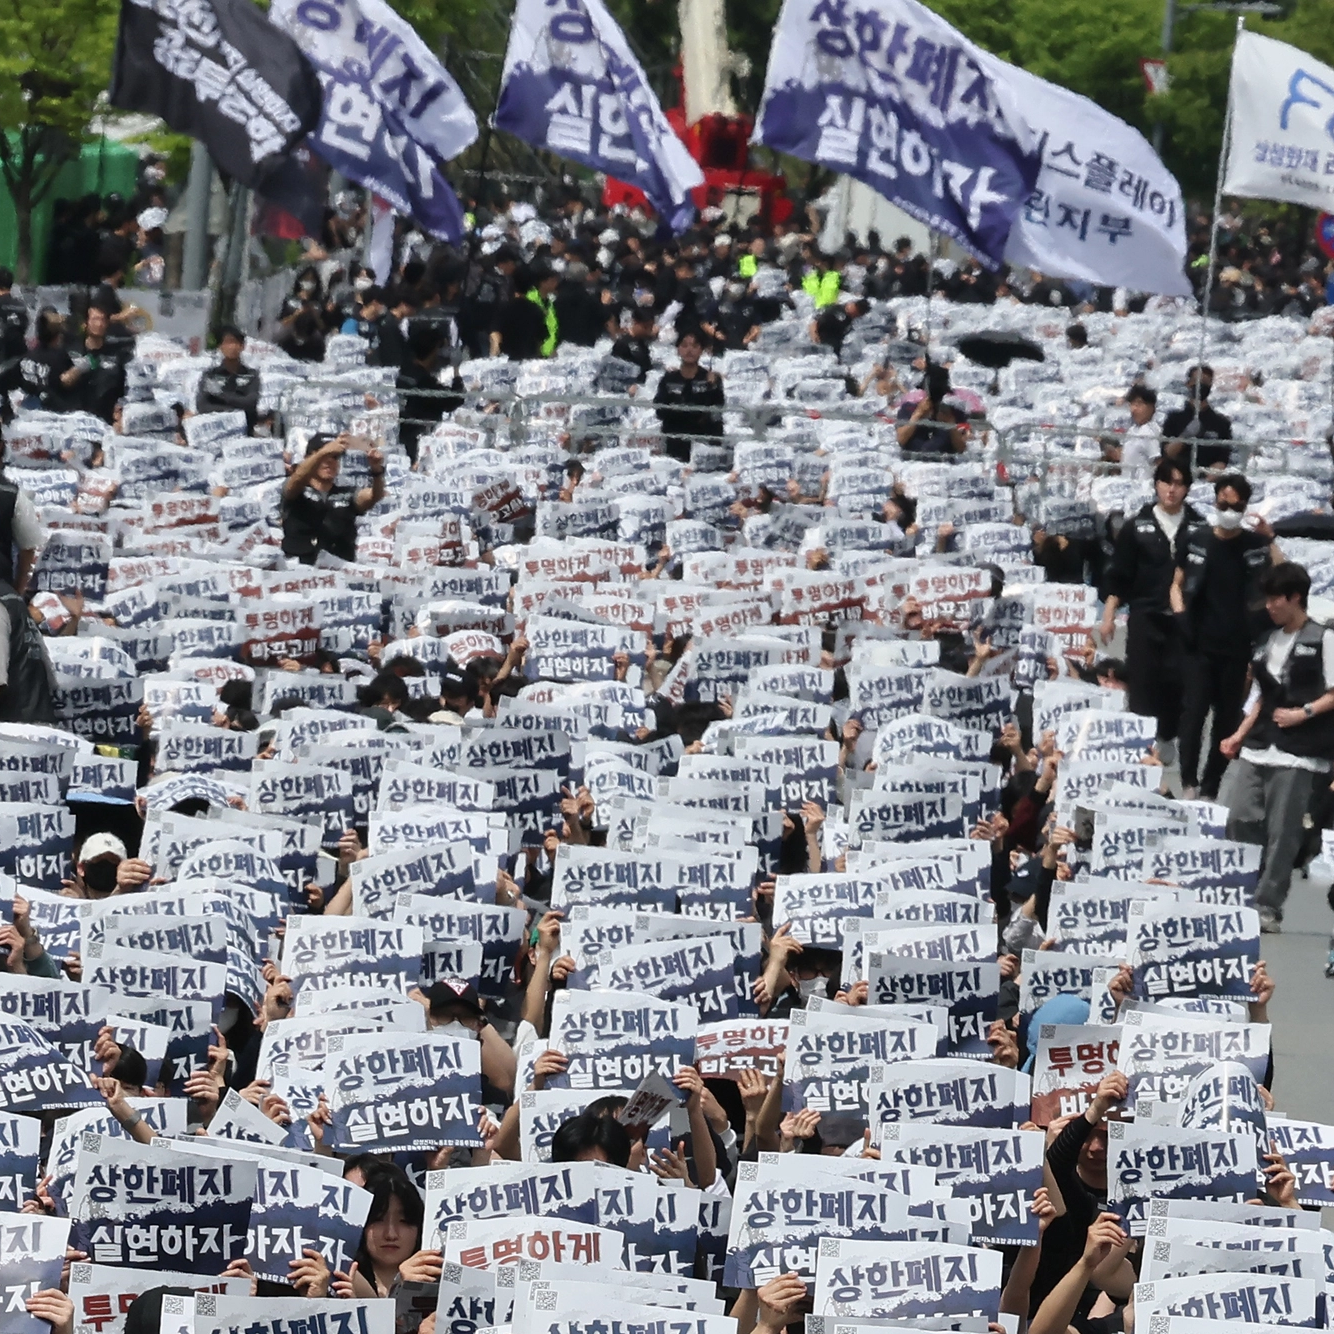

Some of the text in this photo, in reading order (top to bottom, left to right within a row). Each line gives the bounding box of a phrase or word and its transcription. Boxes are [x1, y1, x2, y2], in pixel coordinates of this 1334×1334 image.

[810, 0, 1004, 125] 상한폐지
[817, 96, 1008, 231] 실현하자
[245, 606, 315, 630] 투명하게
[533, 628, 606, 648] 상한폐지
[537, 656, 613, 677] 실현하자
[466, 735, 555, 767] 상한폐지
[856, 799, 947, 832] 상한폐지
[359, 846, 456, 903] 상한폐지
[565, 860, 662, 893] 상한폐지
[291, 927, 404, 964] 상한폐지
[1137, 912, 1244, 952] 상한폐지
[875, 966, 981, 1005] 상한폐지
[1143, 954, 1256, 996] 실현하자
[562, 1009, 679, 1042] 상한폐지
[1129, 1028, 1251, 1062] 상한폐지
[796, 1027, 917, 1066] 상한폐지
[333, 1042, 463, 1092] 상한폐지
[345, 1094, 482, 1143] 실현하자
[875, 1074, 998, 1123] 상한폐지
[1115, 1137, 1240, 1185] 상한폐지
[84, 1163, 233, 1205] 상한폐지
[742, 1188, 888, 1228] 상한폐지
[89, 1222, 251, 1264] 실현하자
[458, 1230, 601, 1270] 투명하게
[826, 1252, 978, 1301] 상한폐지
